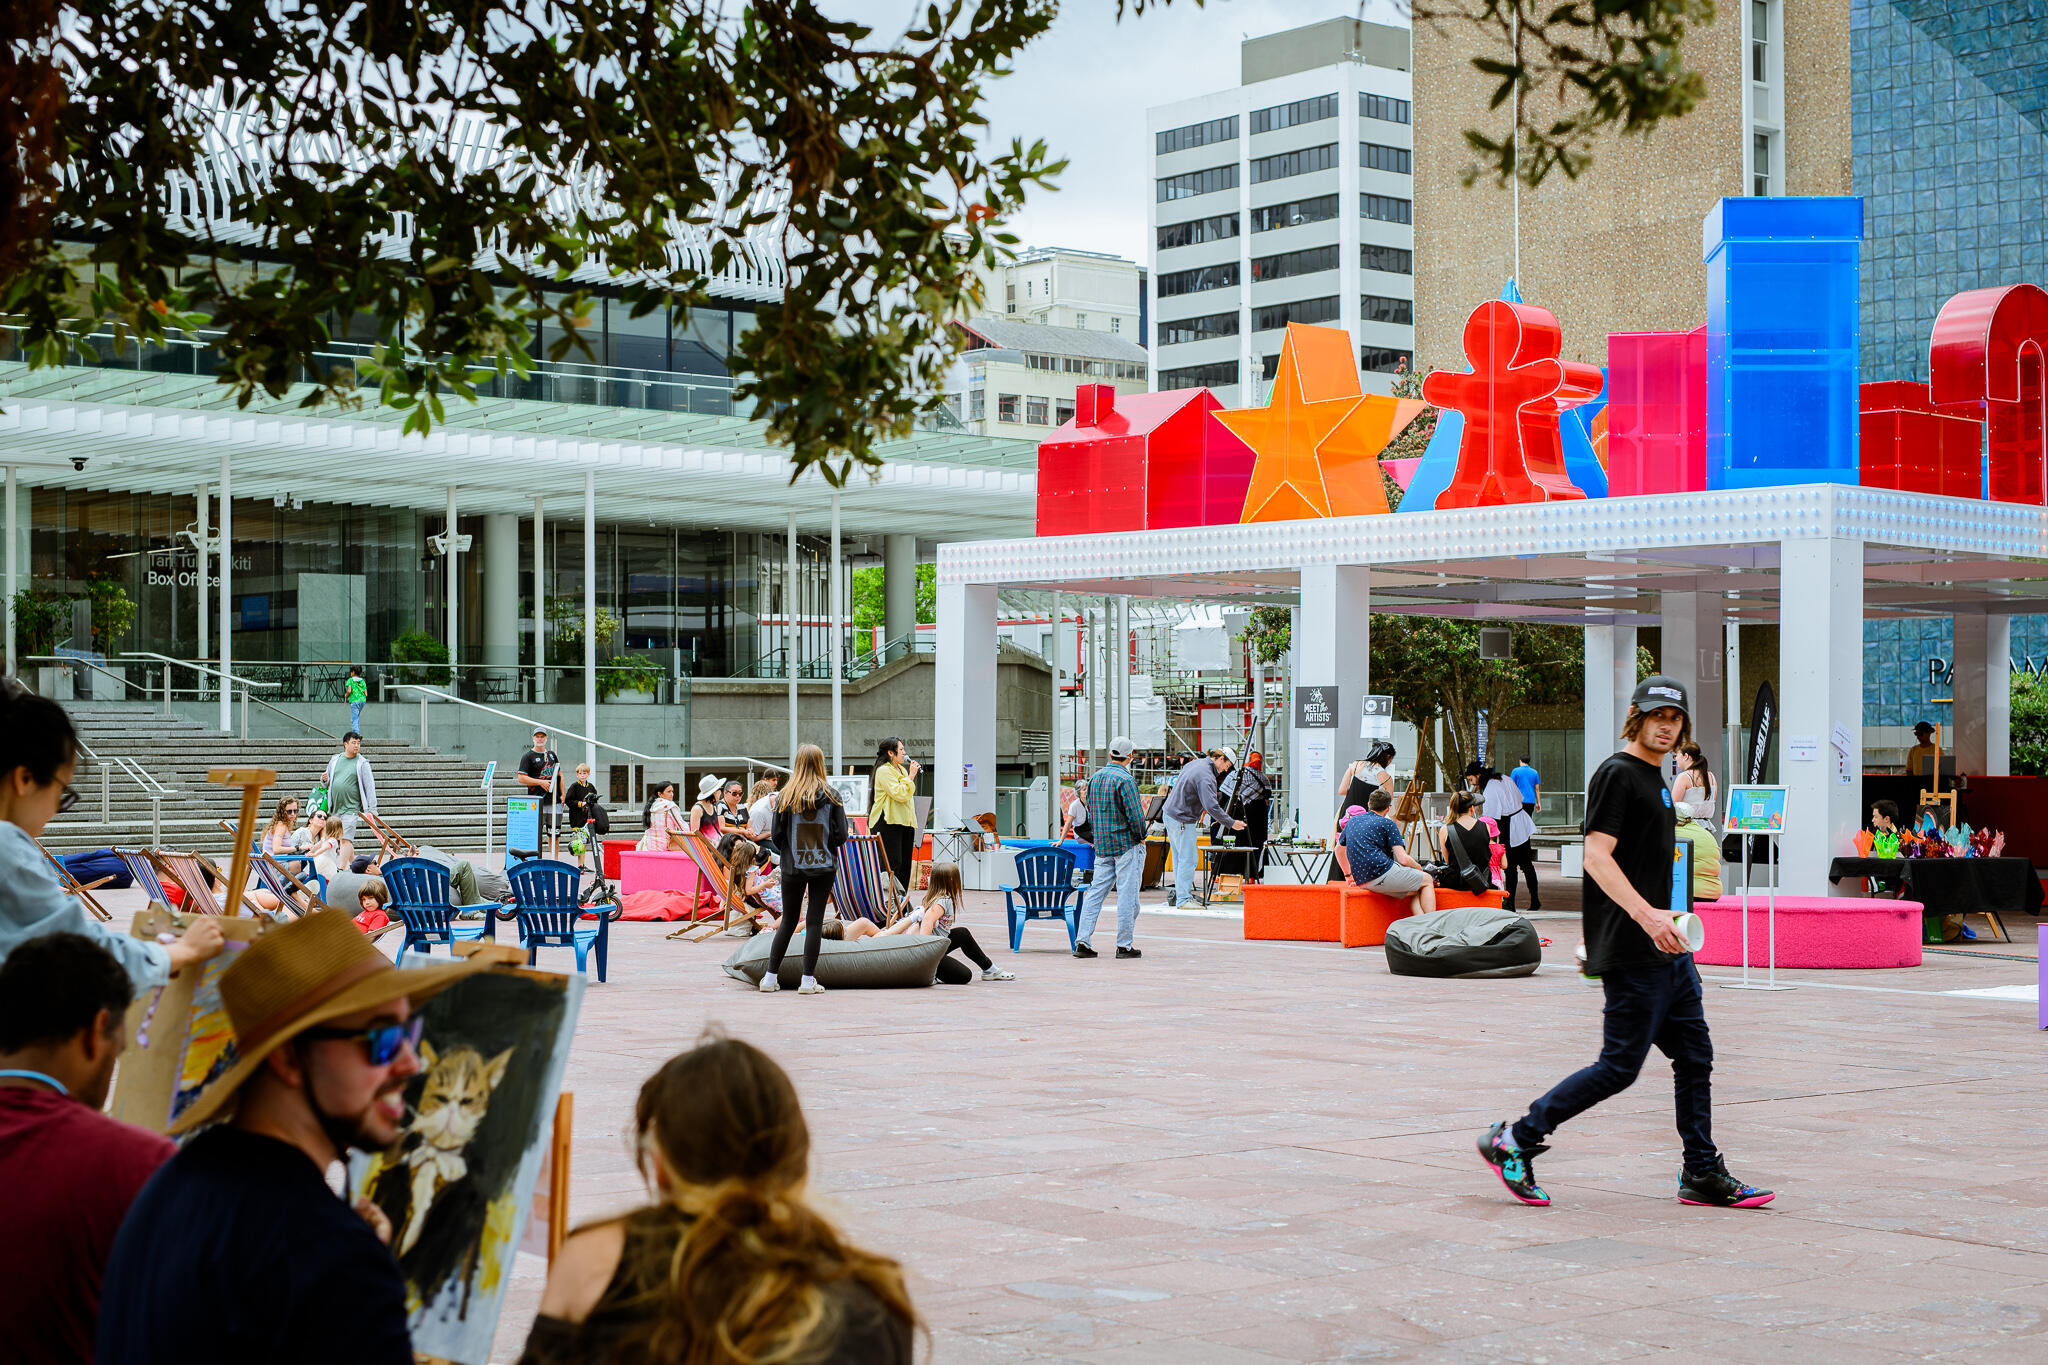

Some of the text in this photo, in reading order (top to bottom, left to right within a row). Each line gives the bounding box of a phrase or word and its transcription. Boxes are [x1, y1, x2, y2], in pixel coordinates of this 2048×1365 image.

[147, 571, 175, 585] Box
[1304, 704, 1320, 713] MEET
[1381, 701, 1387, 712] 1
[1305, 713, 1330, 722] ARTISTS
[1041, 781, 1047, 792] 2
[796, 850, 827, 865] 70.3
